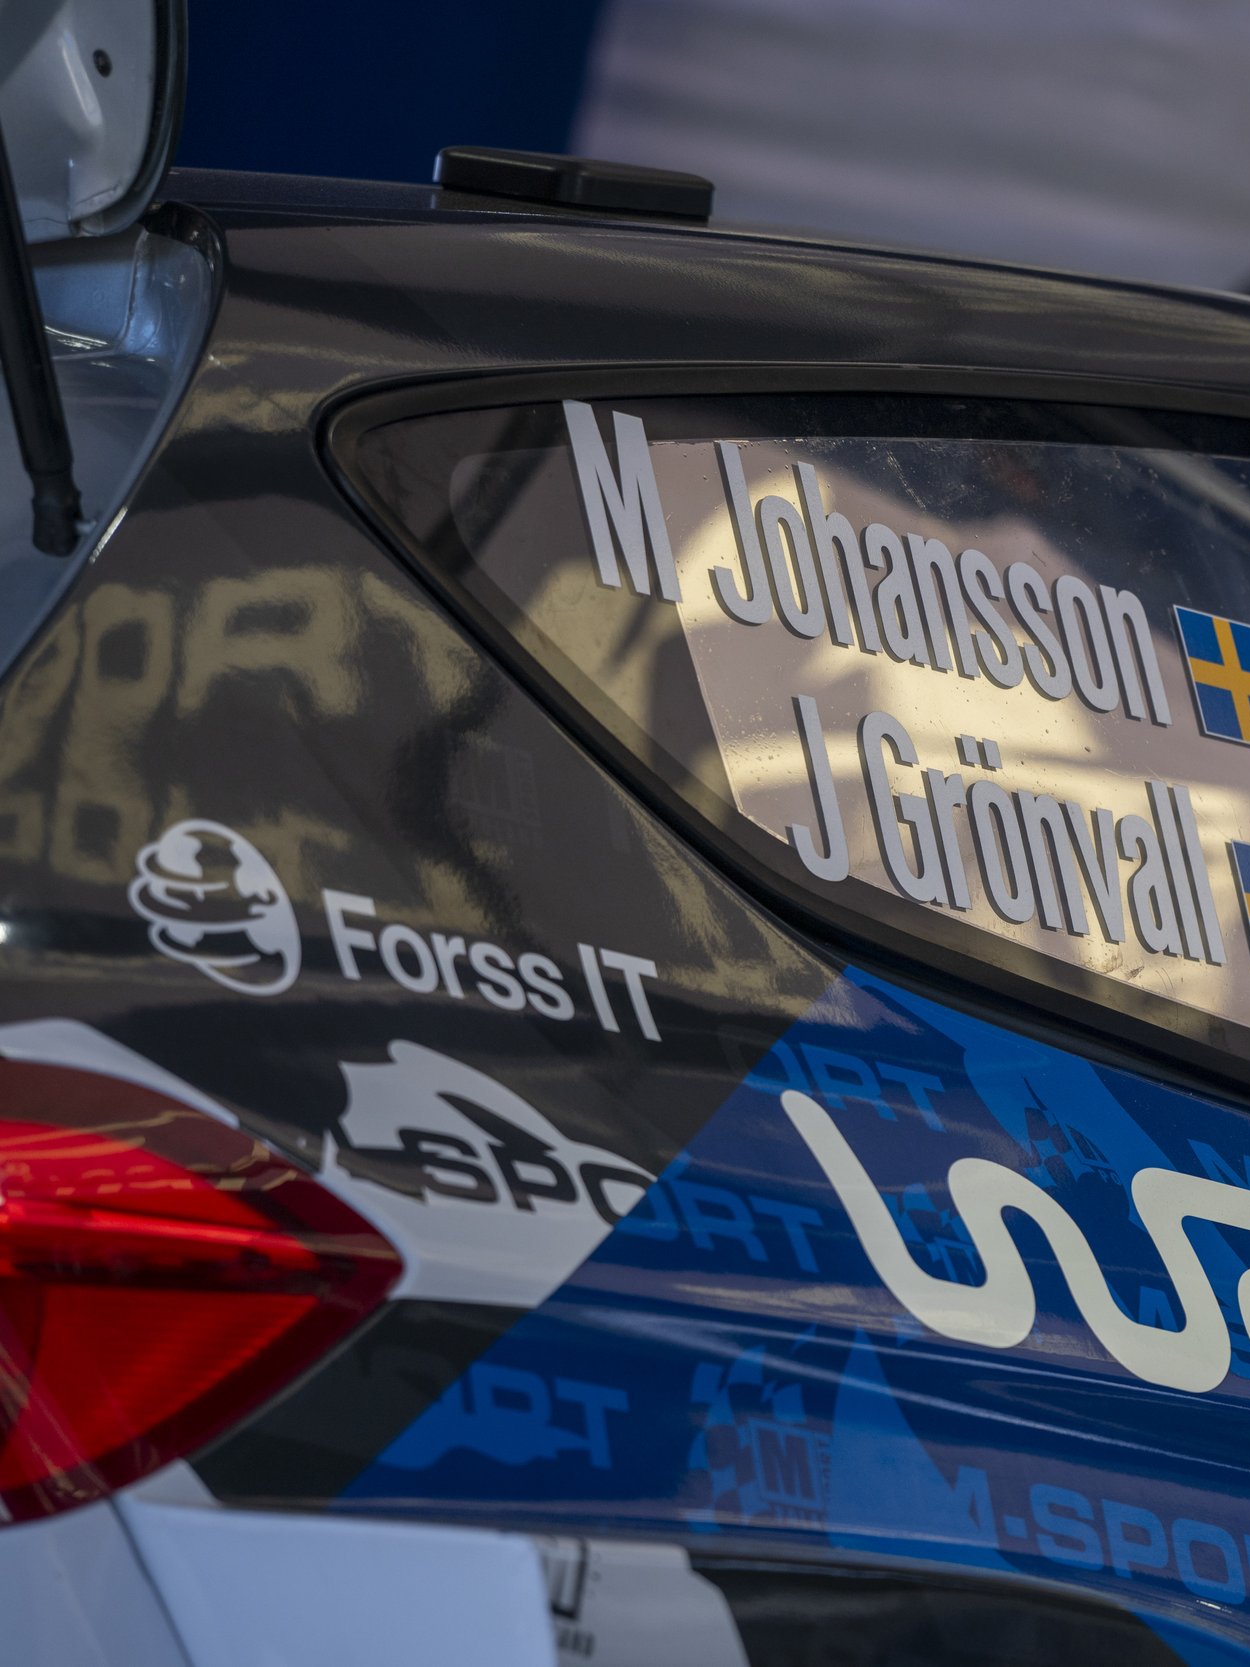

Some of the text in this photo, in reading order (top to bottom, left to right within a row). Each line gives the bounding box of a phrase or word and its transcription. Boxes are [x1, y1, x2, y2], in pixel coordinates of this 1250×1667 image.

[563, 400, 1173, 727] M Johansson
[322, 889, 662, 1041] Forss IT
[785, 695, 849, 882] J
[857, 711, 1228, 966] Grönvall
